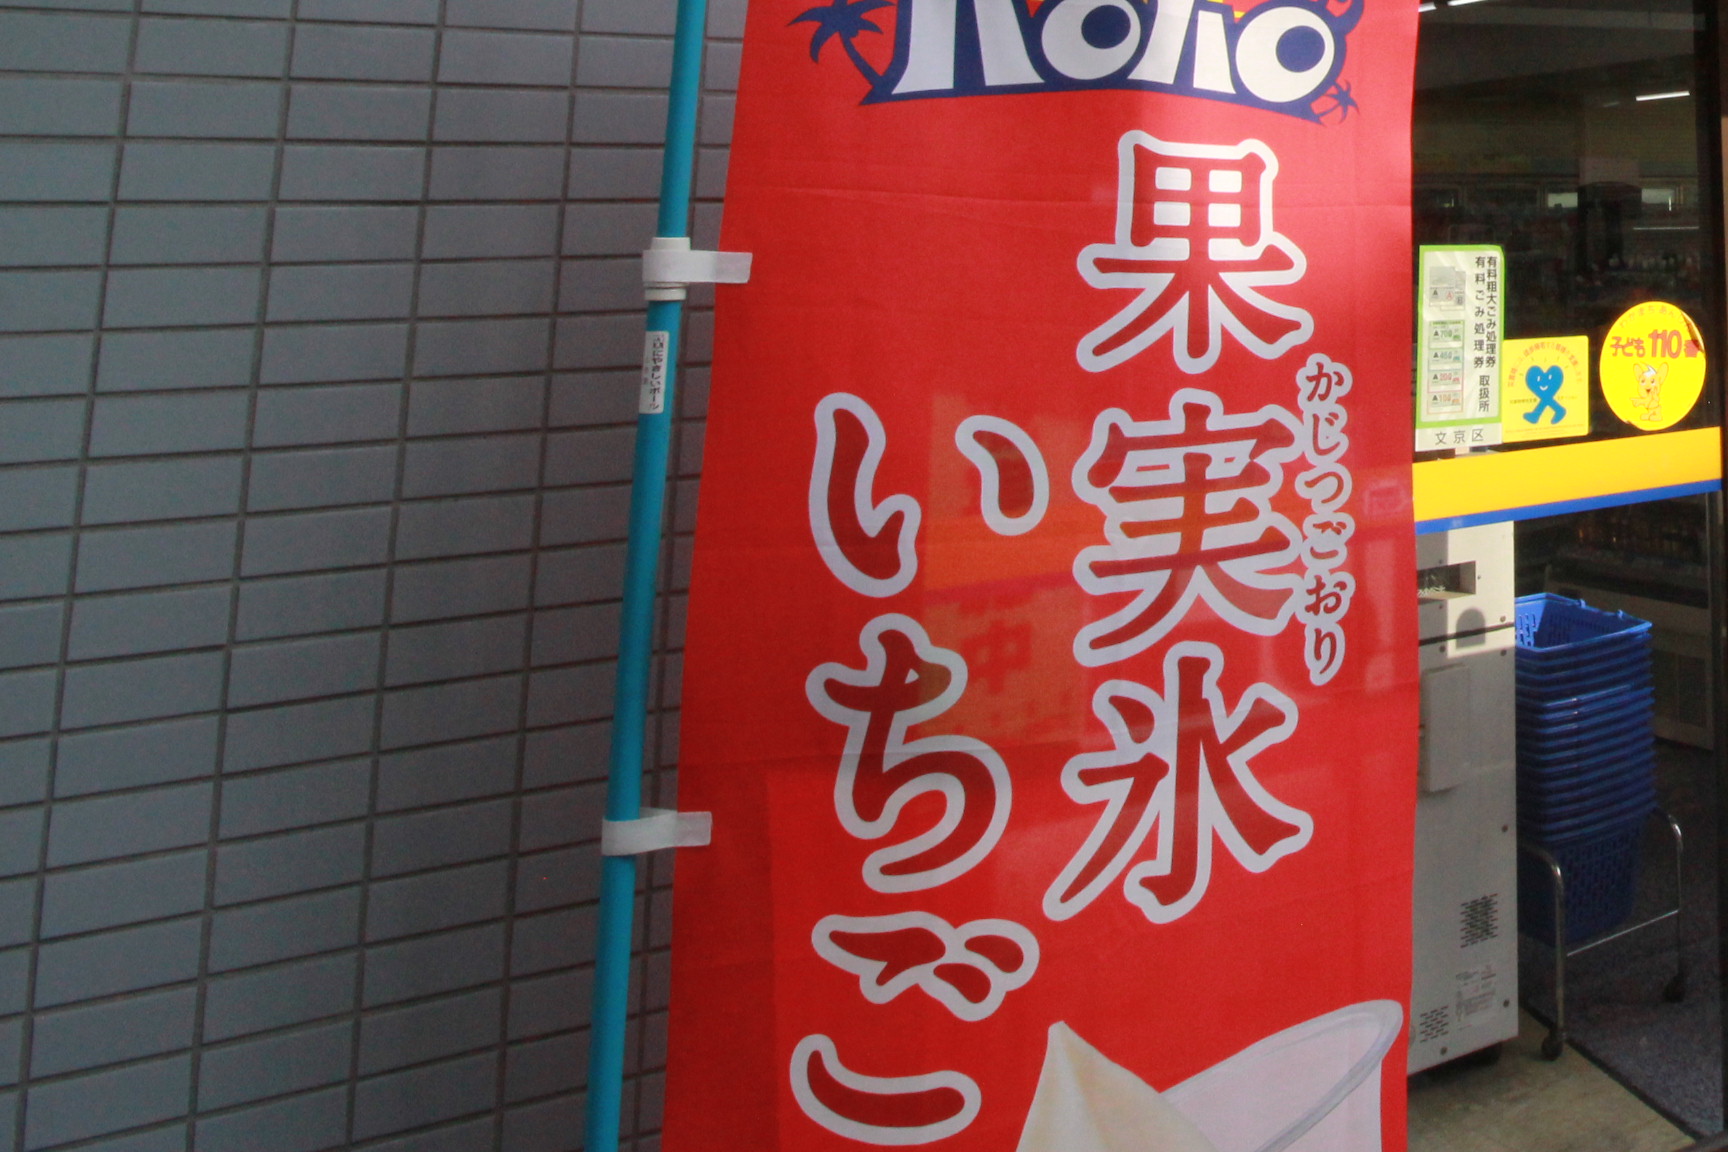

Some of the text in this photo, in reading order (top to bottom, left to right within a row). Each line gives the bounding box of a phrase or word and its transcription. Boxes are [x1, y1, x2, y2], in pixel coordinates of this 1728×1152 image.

[1473, 256, 1486, 369] 有料ごみ処理券
[1486, 256, 1498, 368] 有料粗大ごみ処理券
[1435, 428, 1484, 445] 文京区
[1478, 375, 1490, 412] 取扱所
[1042, 129, 1315, 925] 果実氷
[1295, 353, 1353, 686] かじつごおり
[789, 392, 1050, 1146] いちご
